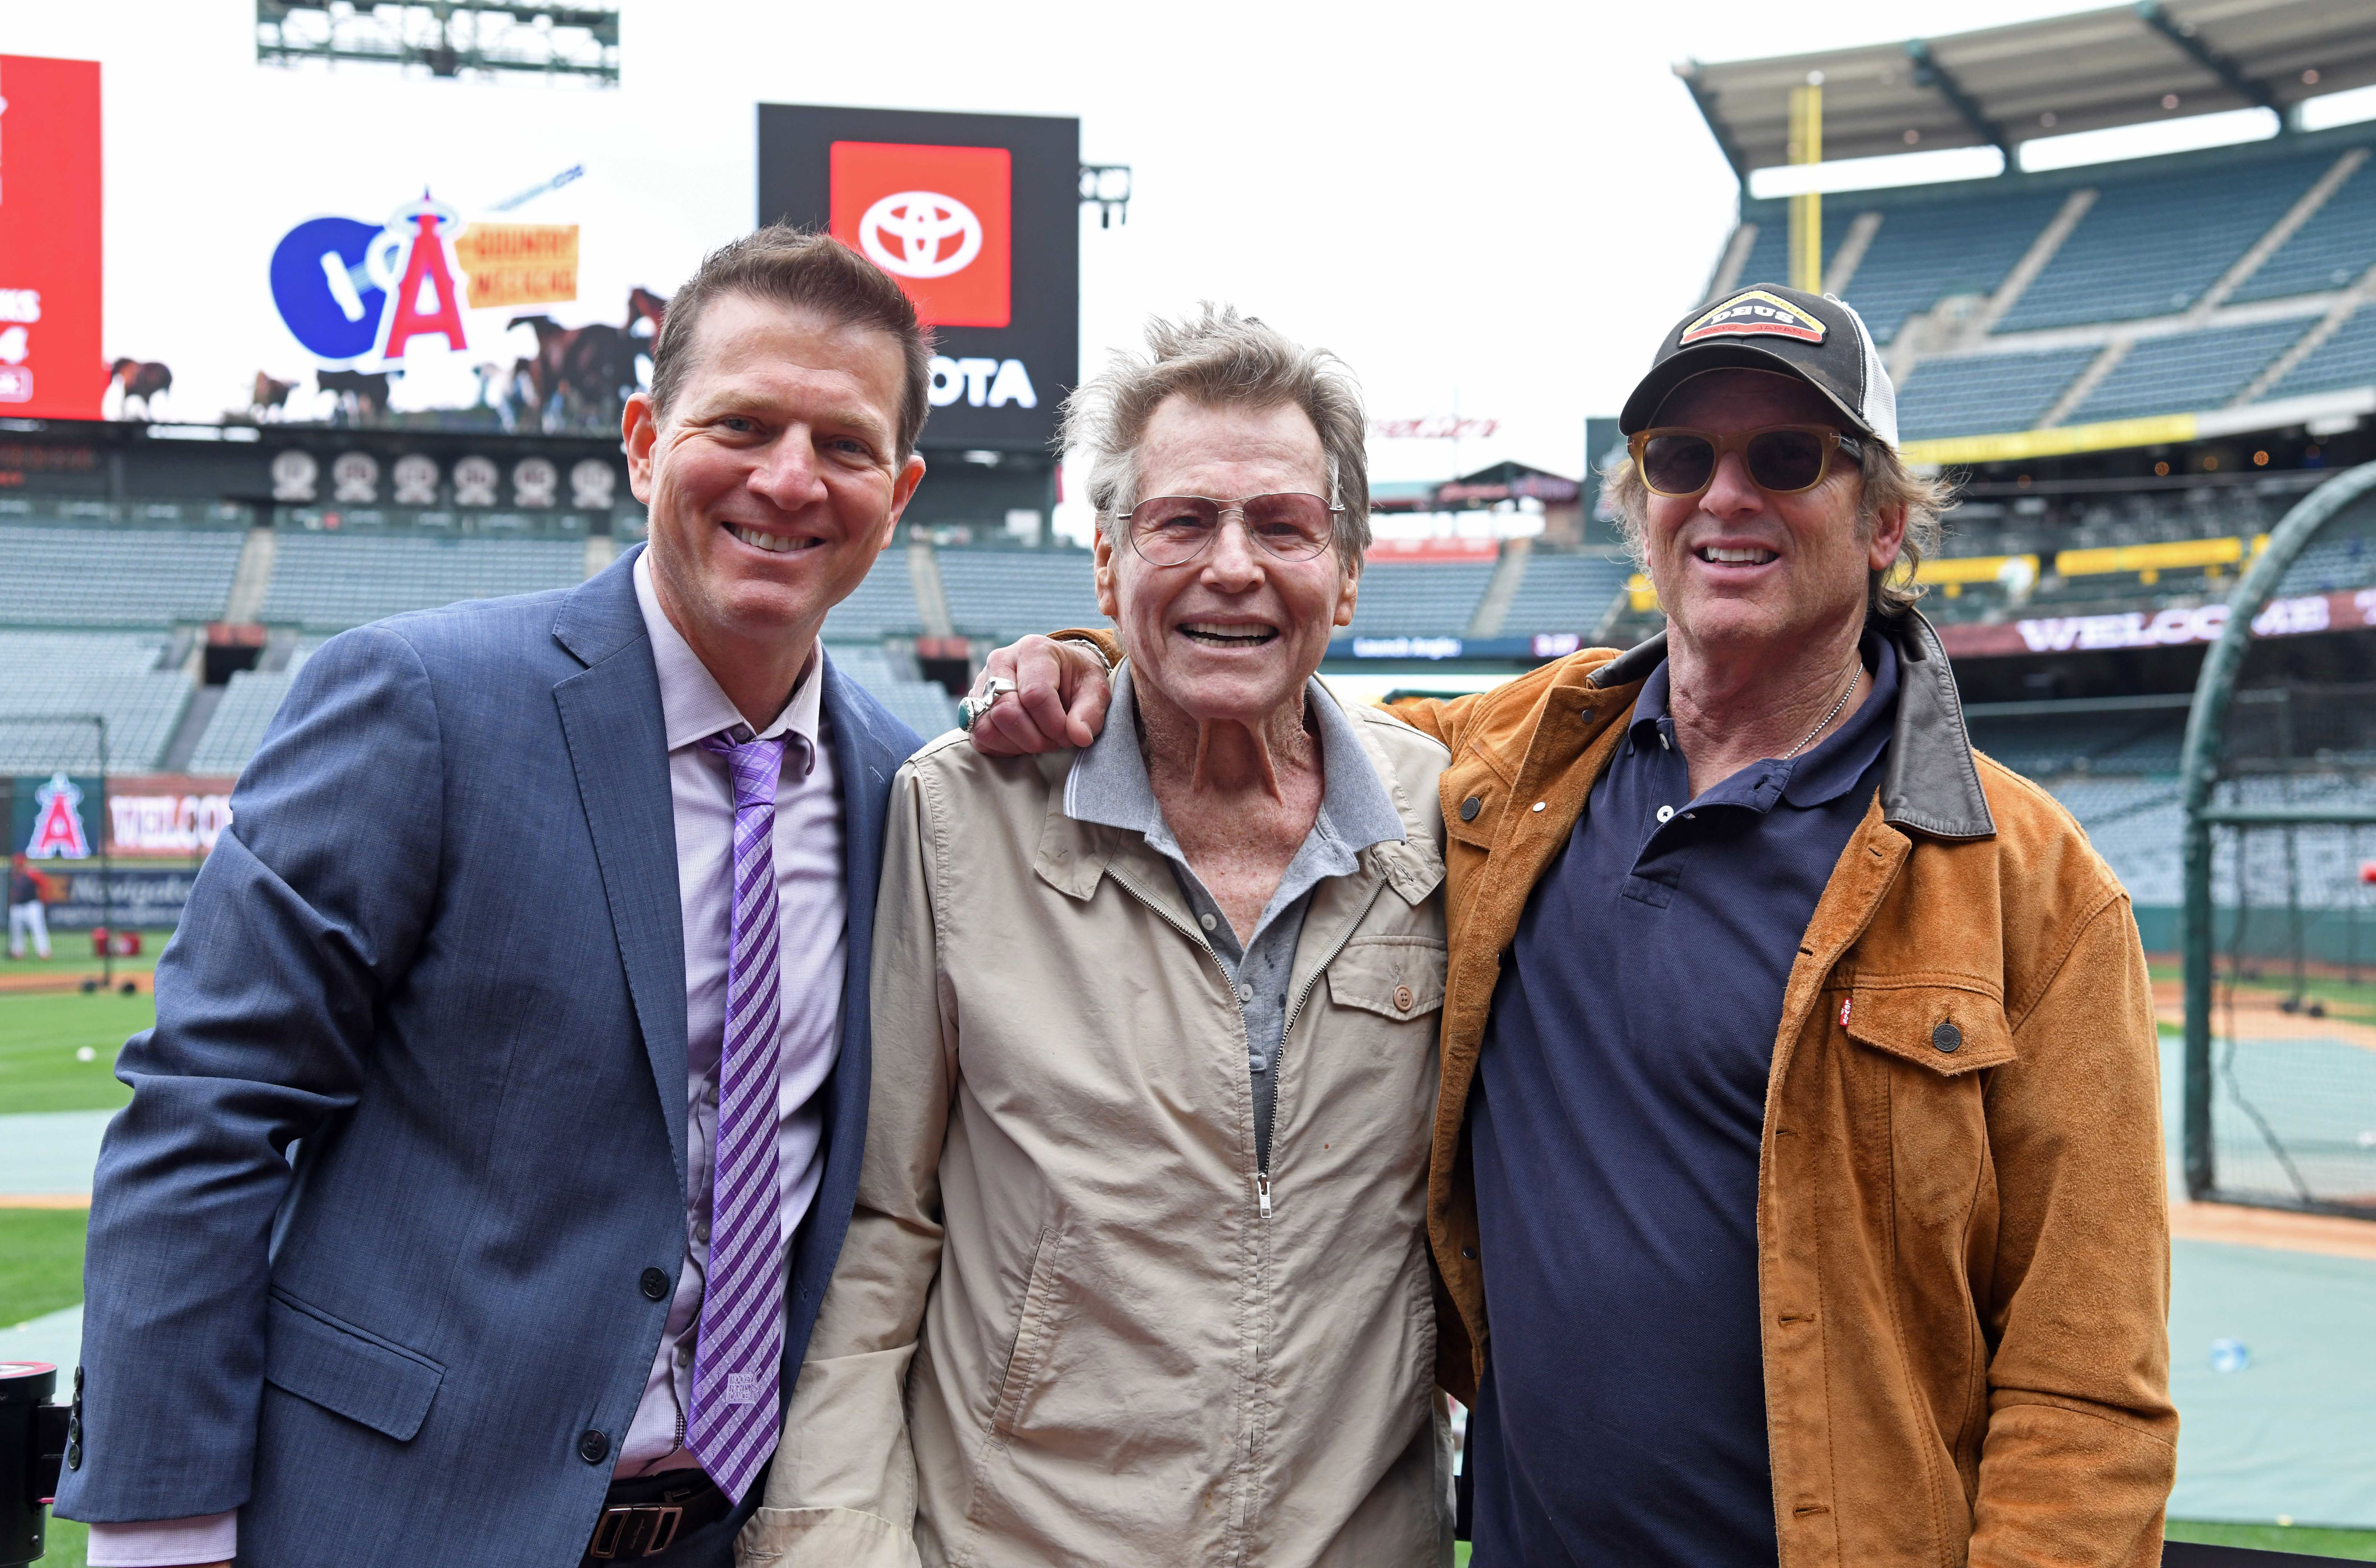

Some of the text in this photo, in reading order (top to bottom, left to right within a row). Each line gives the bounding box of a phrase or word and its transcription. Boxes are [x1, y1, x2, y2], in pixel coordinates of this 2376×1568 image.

[1710, 304, 1795, 325] DEUS
[1763, 294, 1813, 324] CYCLES
[1697, 324, 1803, 336] TOKYO JAPAN
[927, 355, 1038, 408] OTA
[109, 794, 234, 850] WELCO
[730, 1375, 754, 1384] HOCKEY
